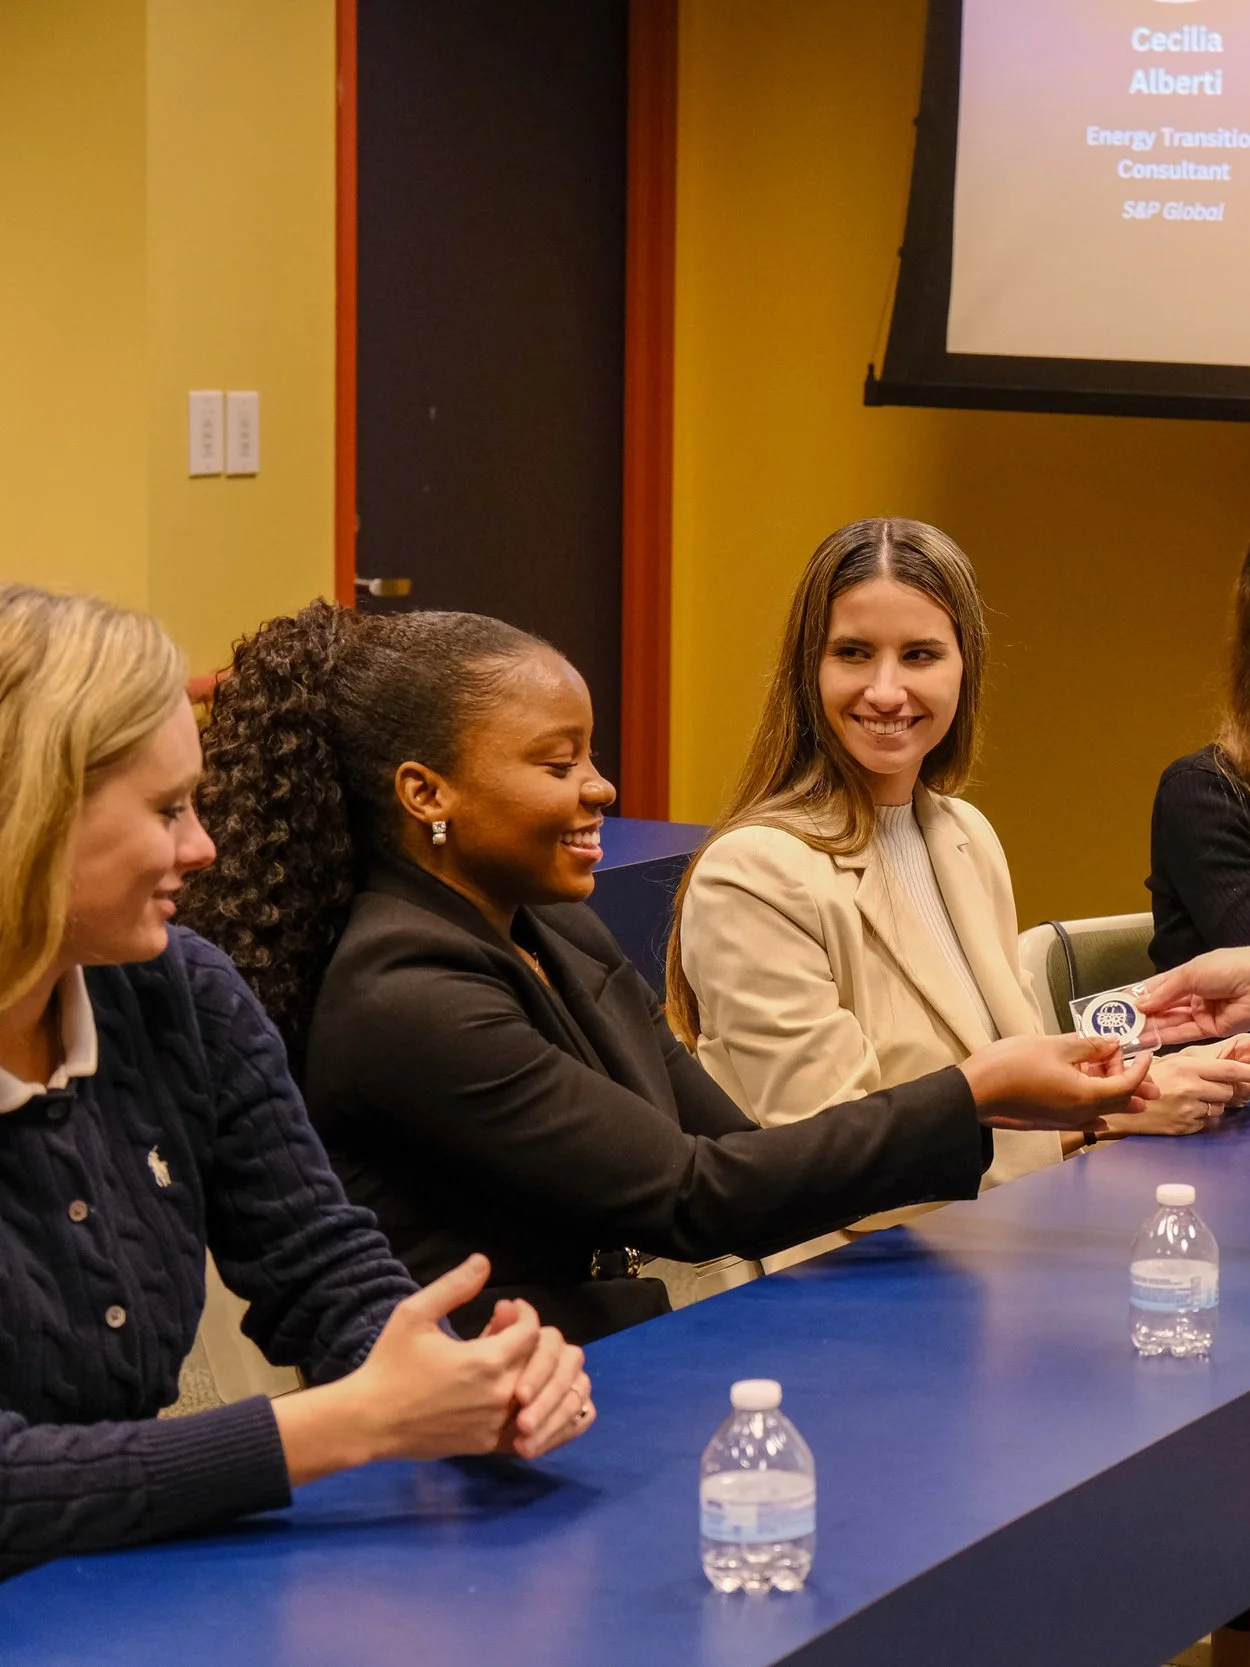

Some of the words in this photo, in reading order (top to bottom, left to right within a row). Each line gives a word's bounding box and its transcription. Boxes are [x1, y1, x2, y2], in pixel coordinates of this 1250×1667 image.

[1131, 24, 1224, 52] Cecilia
[1128, 67, 1223, 95] Alberti
[1086, 126, 1156, 151] Energy
[1117, 159, 1231, 181] Consultant
[1122, 200, 1160, 219] S&P
[1163, 201, 1225, 221] Global
